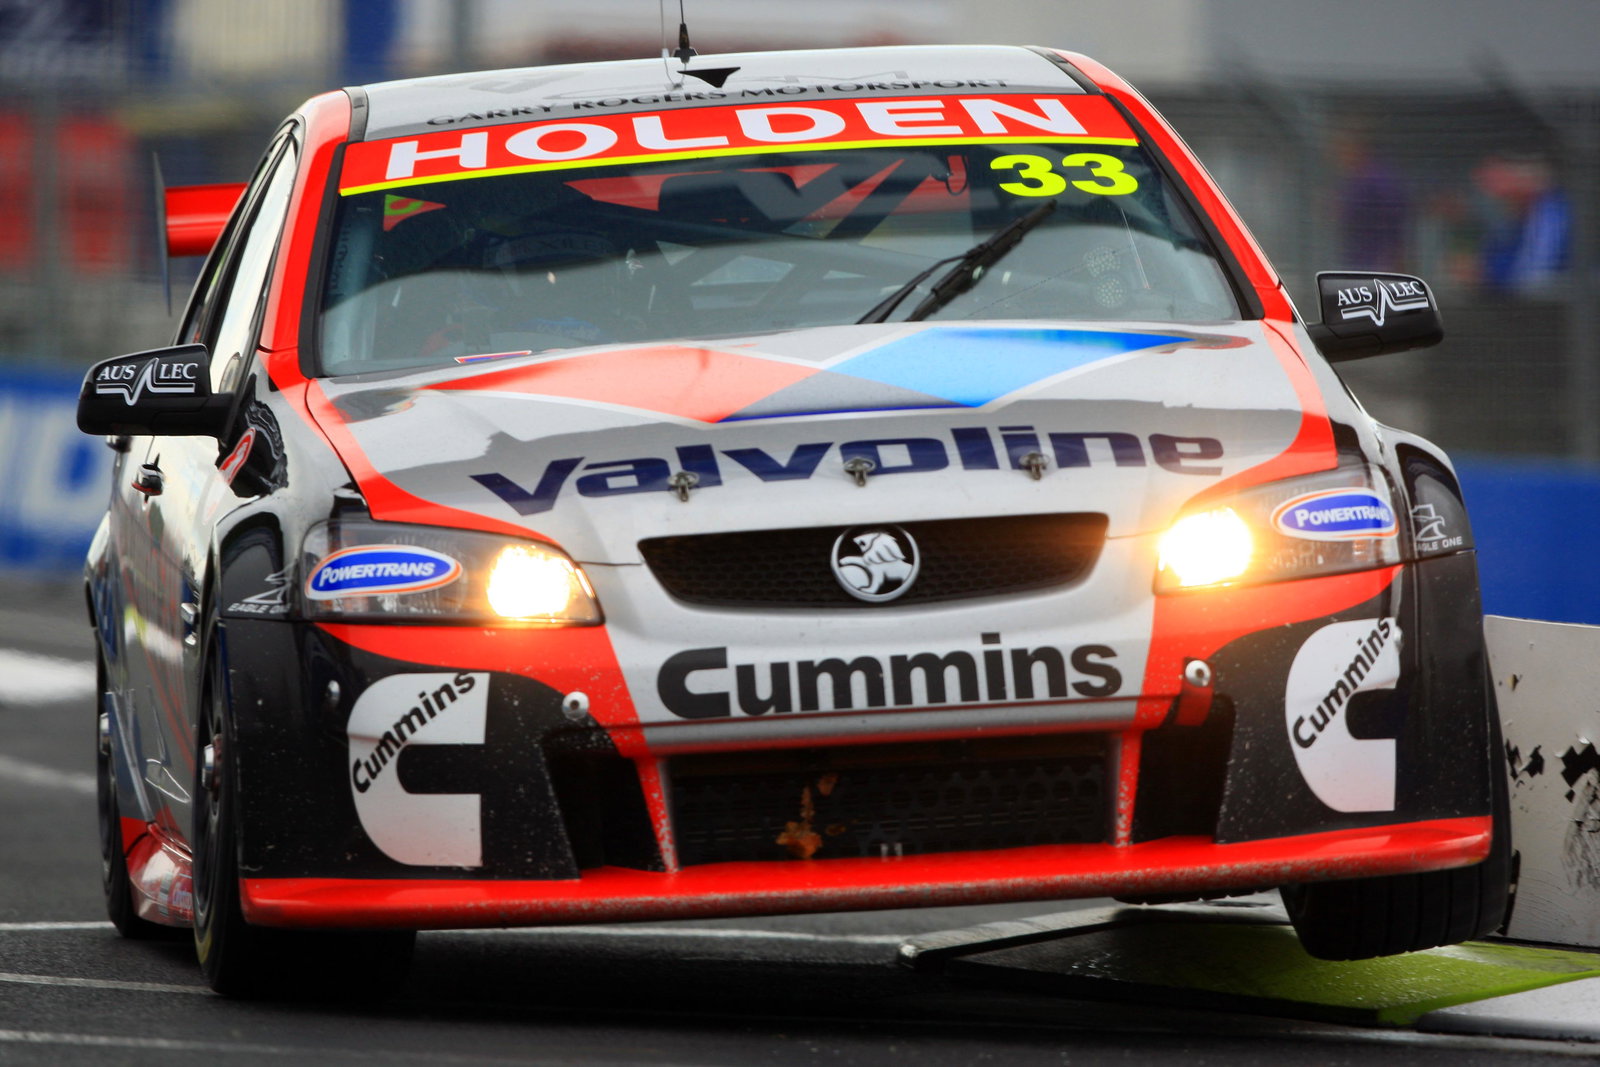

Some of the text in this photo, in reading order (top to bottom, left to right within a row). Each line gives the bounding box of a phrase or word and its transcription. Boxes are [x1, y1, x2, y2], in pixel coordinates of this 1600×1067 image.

[426, 79, 1009, 126] GARRY ROGERS MOTORSPORT
[385, 98, 1089, 180] HOLDEN
[989, 153, 1139, 197] 33
[469, 425, 1224, 516] Valvoline
[1442, 536, 1463, 548] ONE
[318, 562, 435, 587] POWERTRANS
[227, 602, 269, 614] EAGLE
[657, 632, 1122, 720] Cummins
[1292, 617, 1390, 749] Cummins
[352, 671, 476, 793] Cummins
